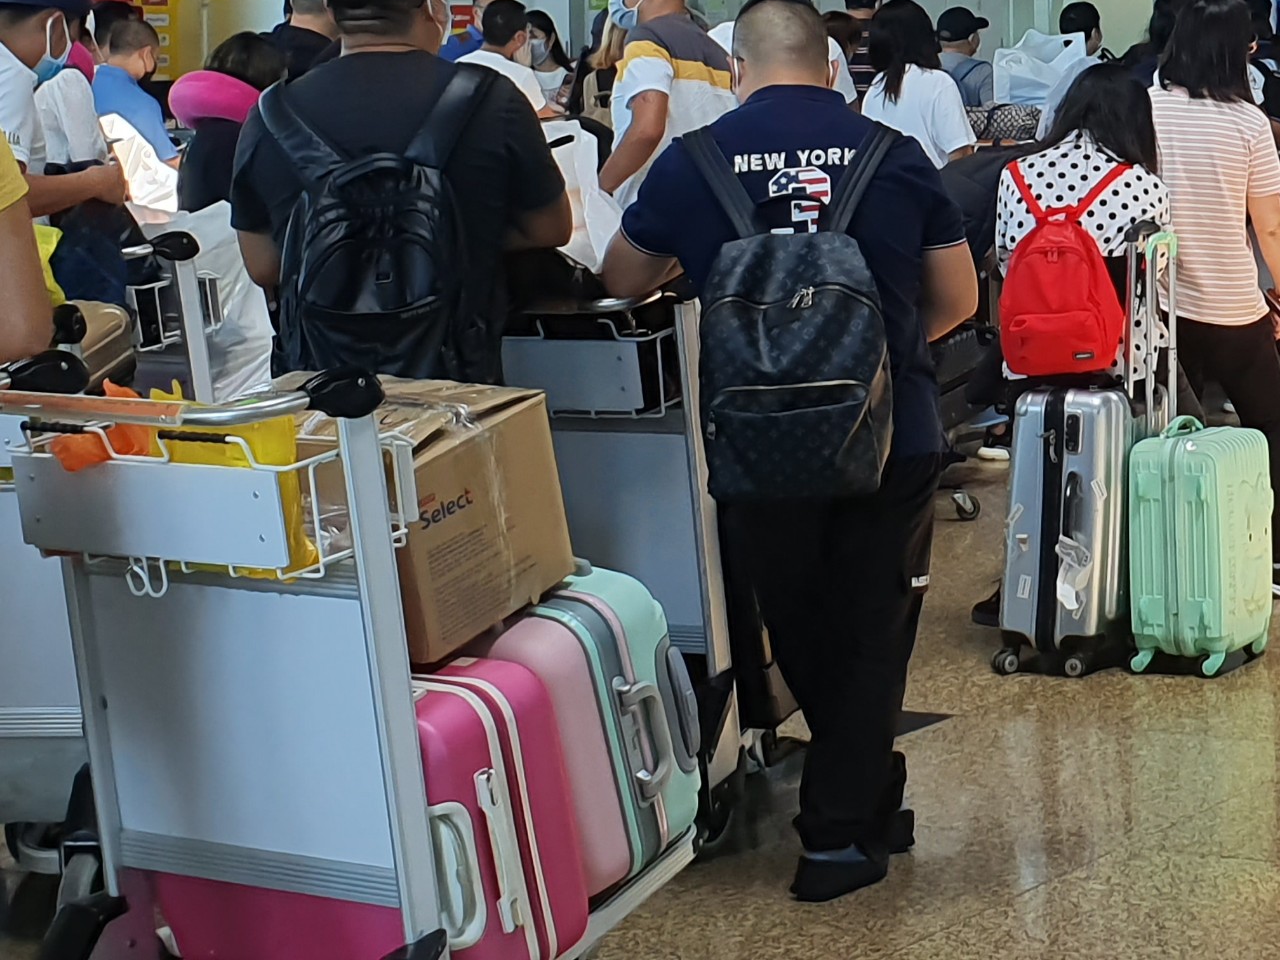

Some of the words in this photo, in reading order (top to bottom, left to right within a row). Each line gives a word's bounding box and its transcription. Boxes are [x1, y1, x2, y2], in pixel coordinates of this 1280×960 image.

[734, 151, 786, 174] NEW
[796, 147, 857, 167] YORK
[419, 487, 474, 531] Select
